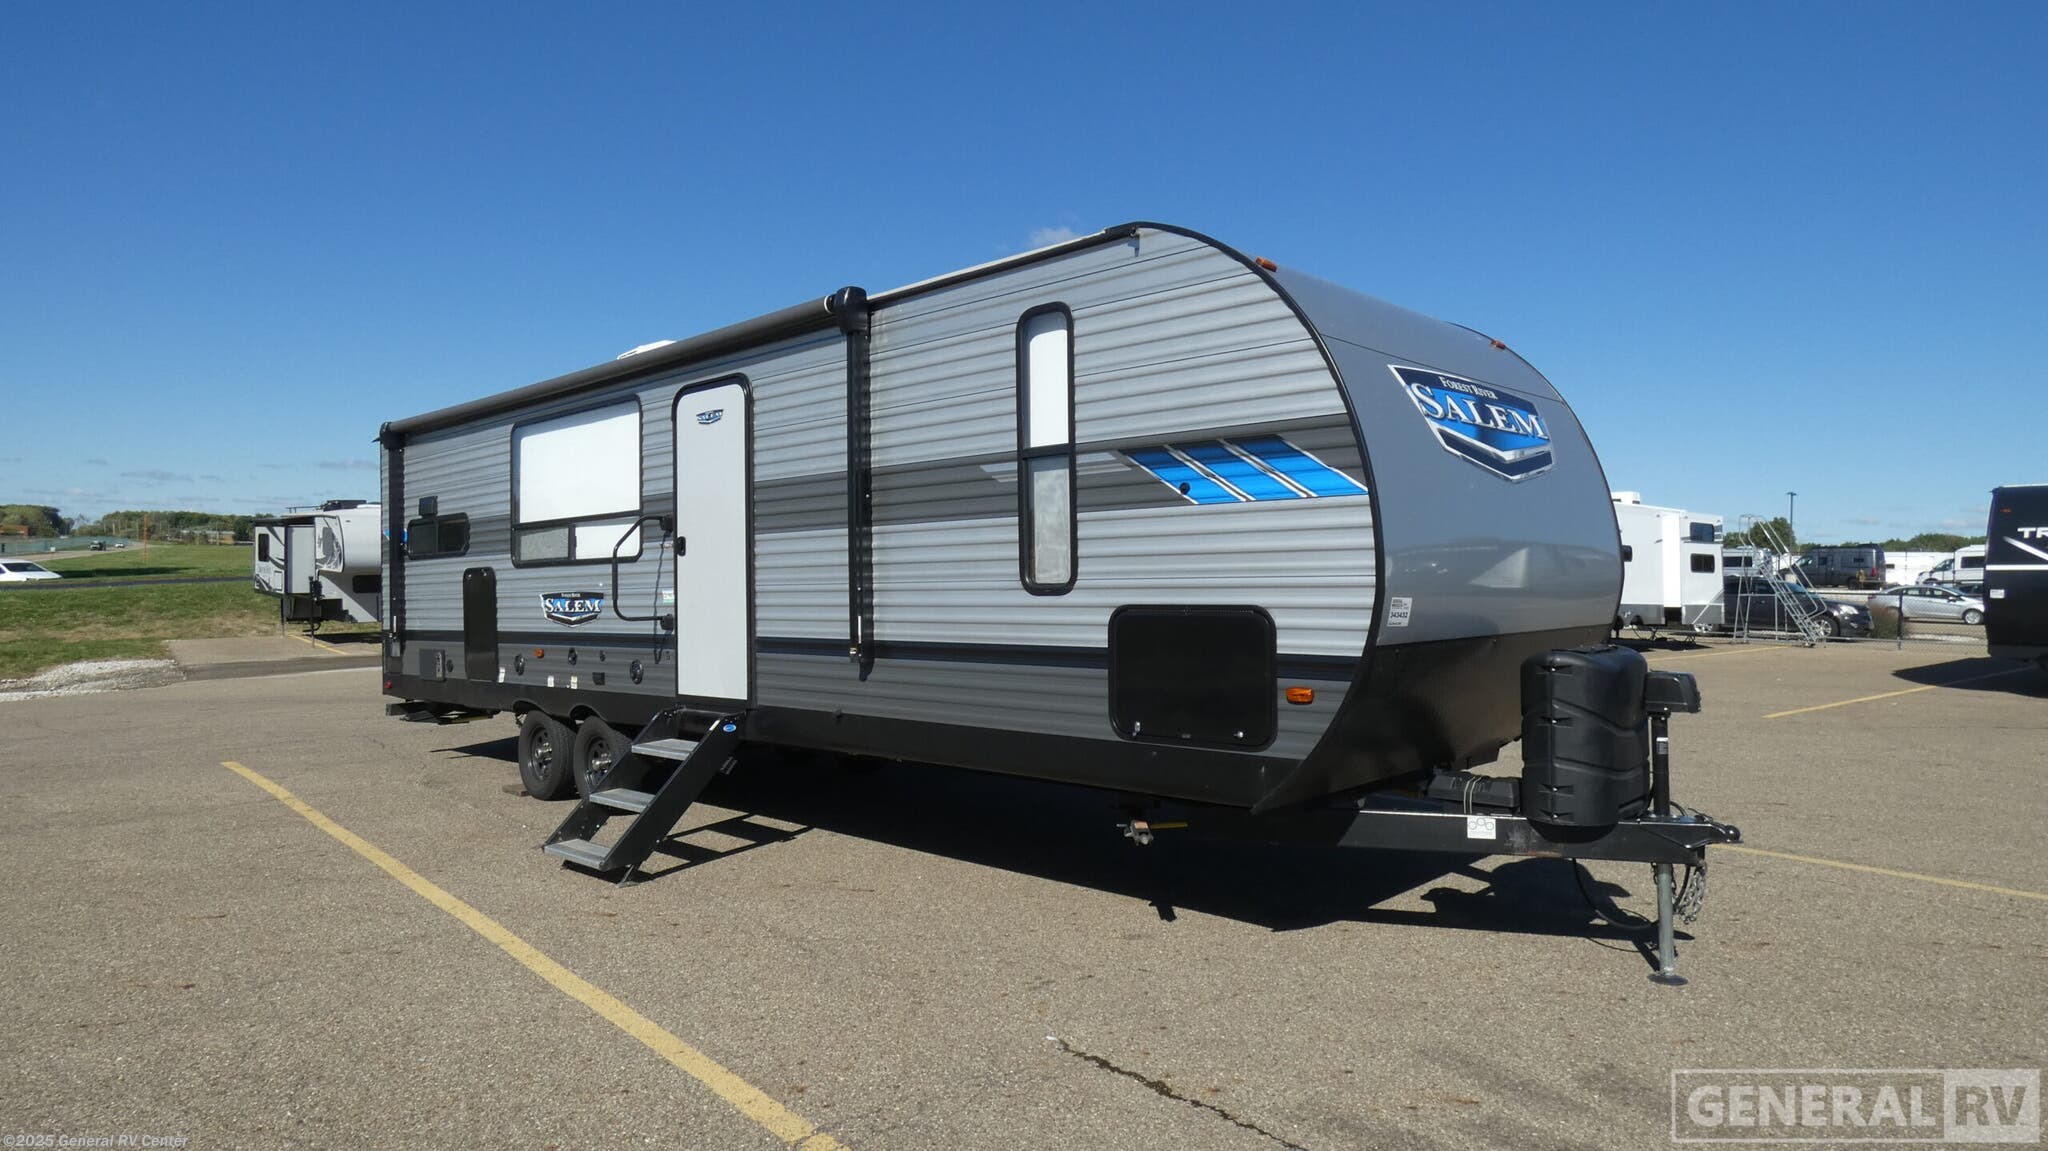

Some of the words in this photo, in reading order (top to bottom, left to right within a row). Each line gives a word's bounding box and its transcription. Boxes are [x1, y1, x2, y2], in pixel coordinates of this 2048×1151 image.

[1439, 376, 1473, 394] FOREST
[1471, 384, 1498, 400] RIVER
[1411, 382, 1550, 440] SALEM
[545, 598, 601, 613] SALEM
